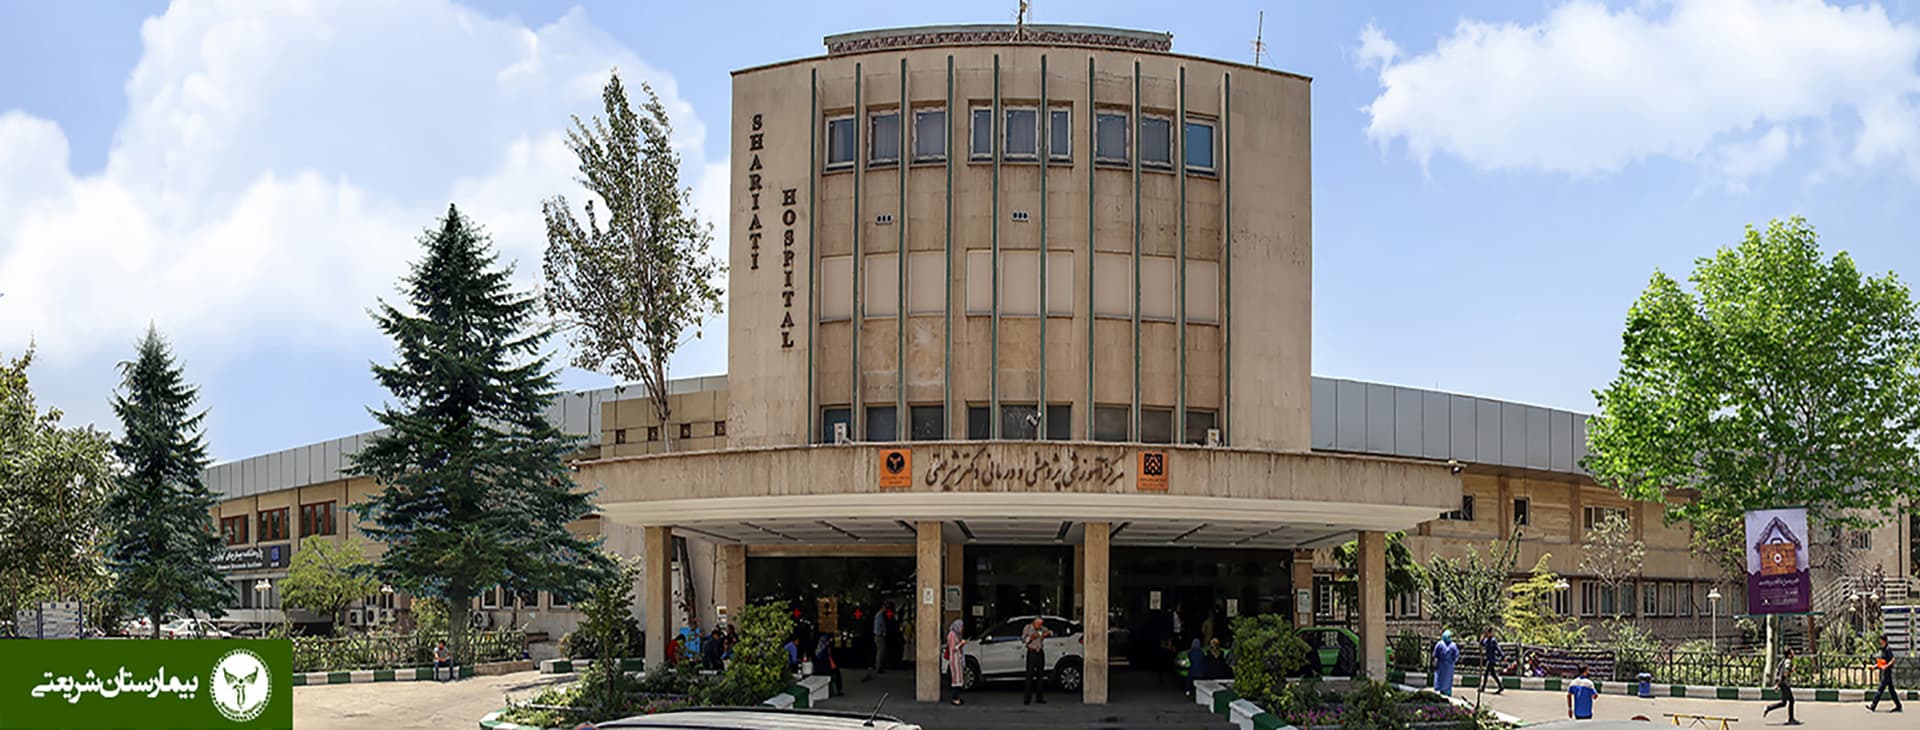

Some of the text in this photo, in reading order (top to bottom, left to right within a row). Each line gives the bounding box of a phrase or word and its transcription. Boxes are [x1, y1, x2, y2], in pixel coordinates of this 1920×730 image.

[749, 114, 764, 270] SHARIATI
[781, 188, 797, 349] HOSPITAL
[925, 450, 961, 491] شریعتی
[954, 447, 987, 487] دکتر
[1062, 451, 1102, 488] آموزشی
[1096, 447, 1128, 486] مرکز
